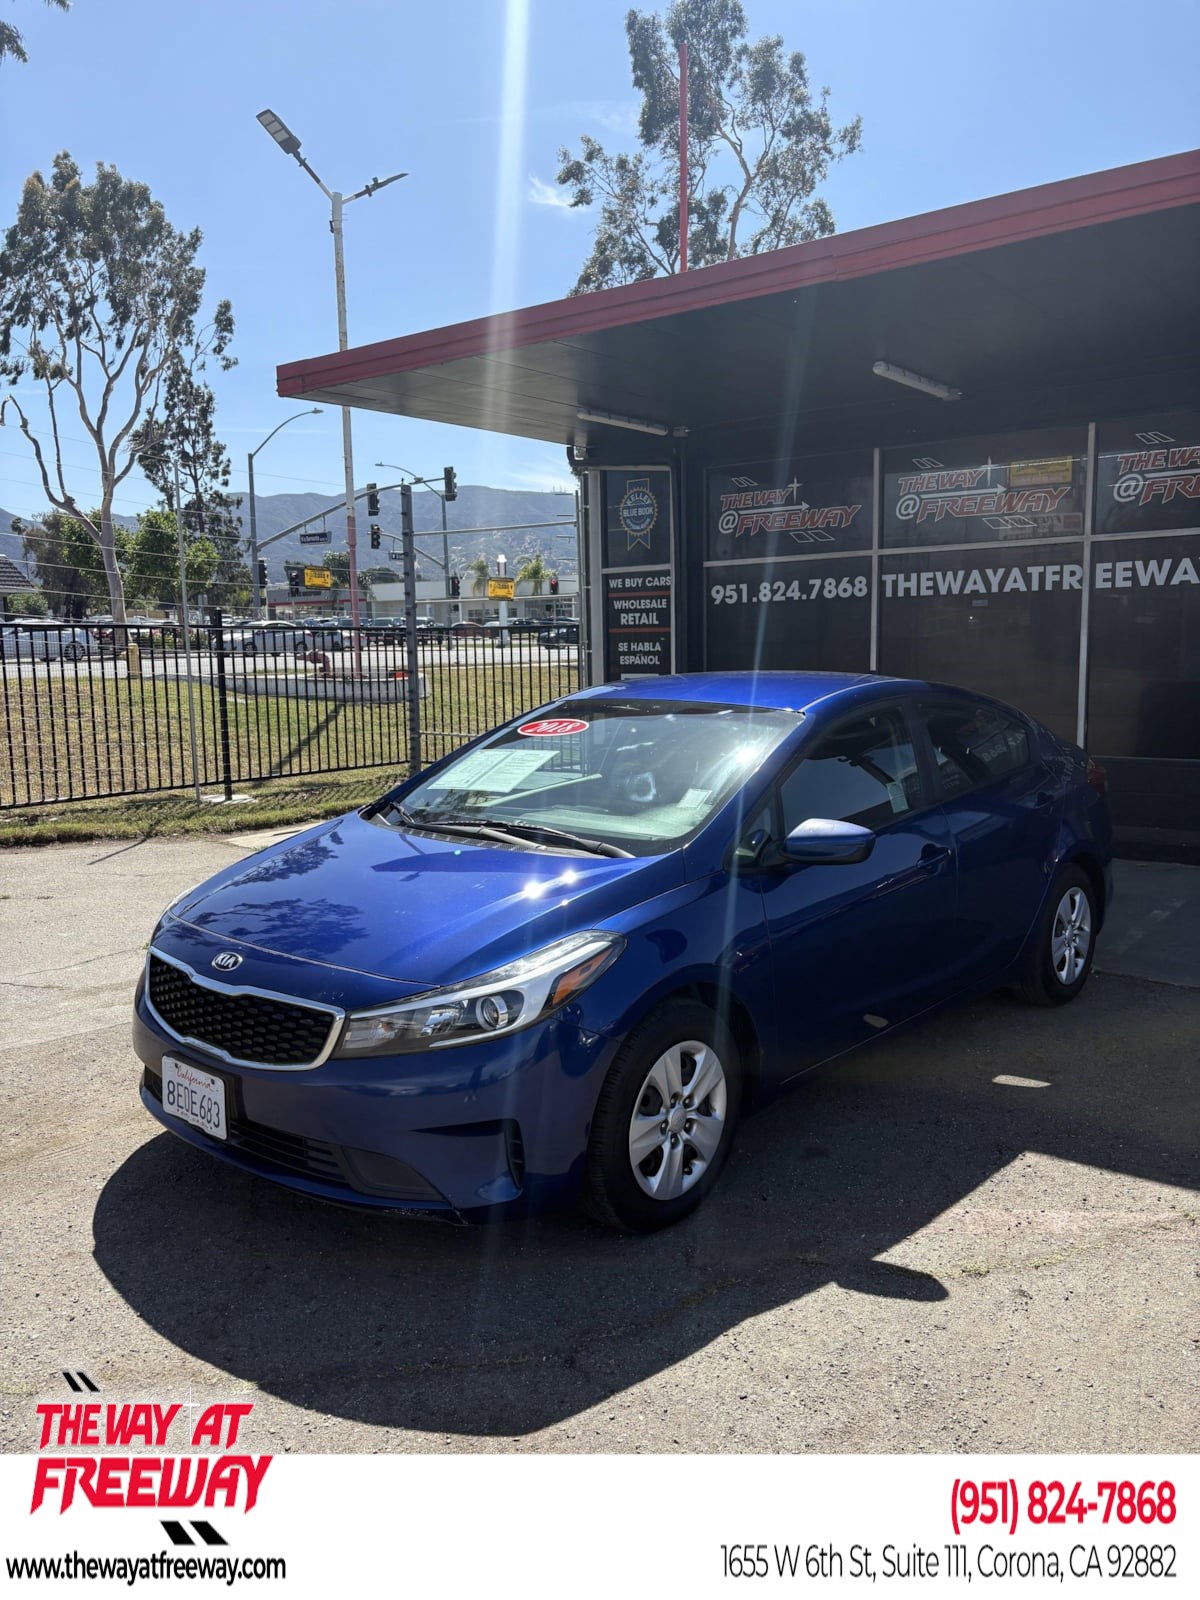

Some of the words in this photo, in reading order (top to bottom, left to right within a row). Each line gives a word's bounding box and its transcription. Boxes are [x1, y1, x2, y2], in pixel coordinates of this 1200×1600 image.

[609, 579, 623, 588] WE
[625, 578, 643, 588] BUY
[645, 576, 671, 587] CARS
[710, 576, 868, 605] 951.824.7868
[613, 599, 667, 609] WHOLESALE
[620, 612, 659, 625] RETAIL
[618, 642, 629, 652] SE
[630, 642, 661, 652] HABLA
[619, 652, 660, 665] ESPAÑOL
[524, 722, 581, 733] 2018
[215, 954, 237, 969] KIA
[175, 1065, 216, 1093] California
[167, 1080, 220, 1128] 8EDE683
